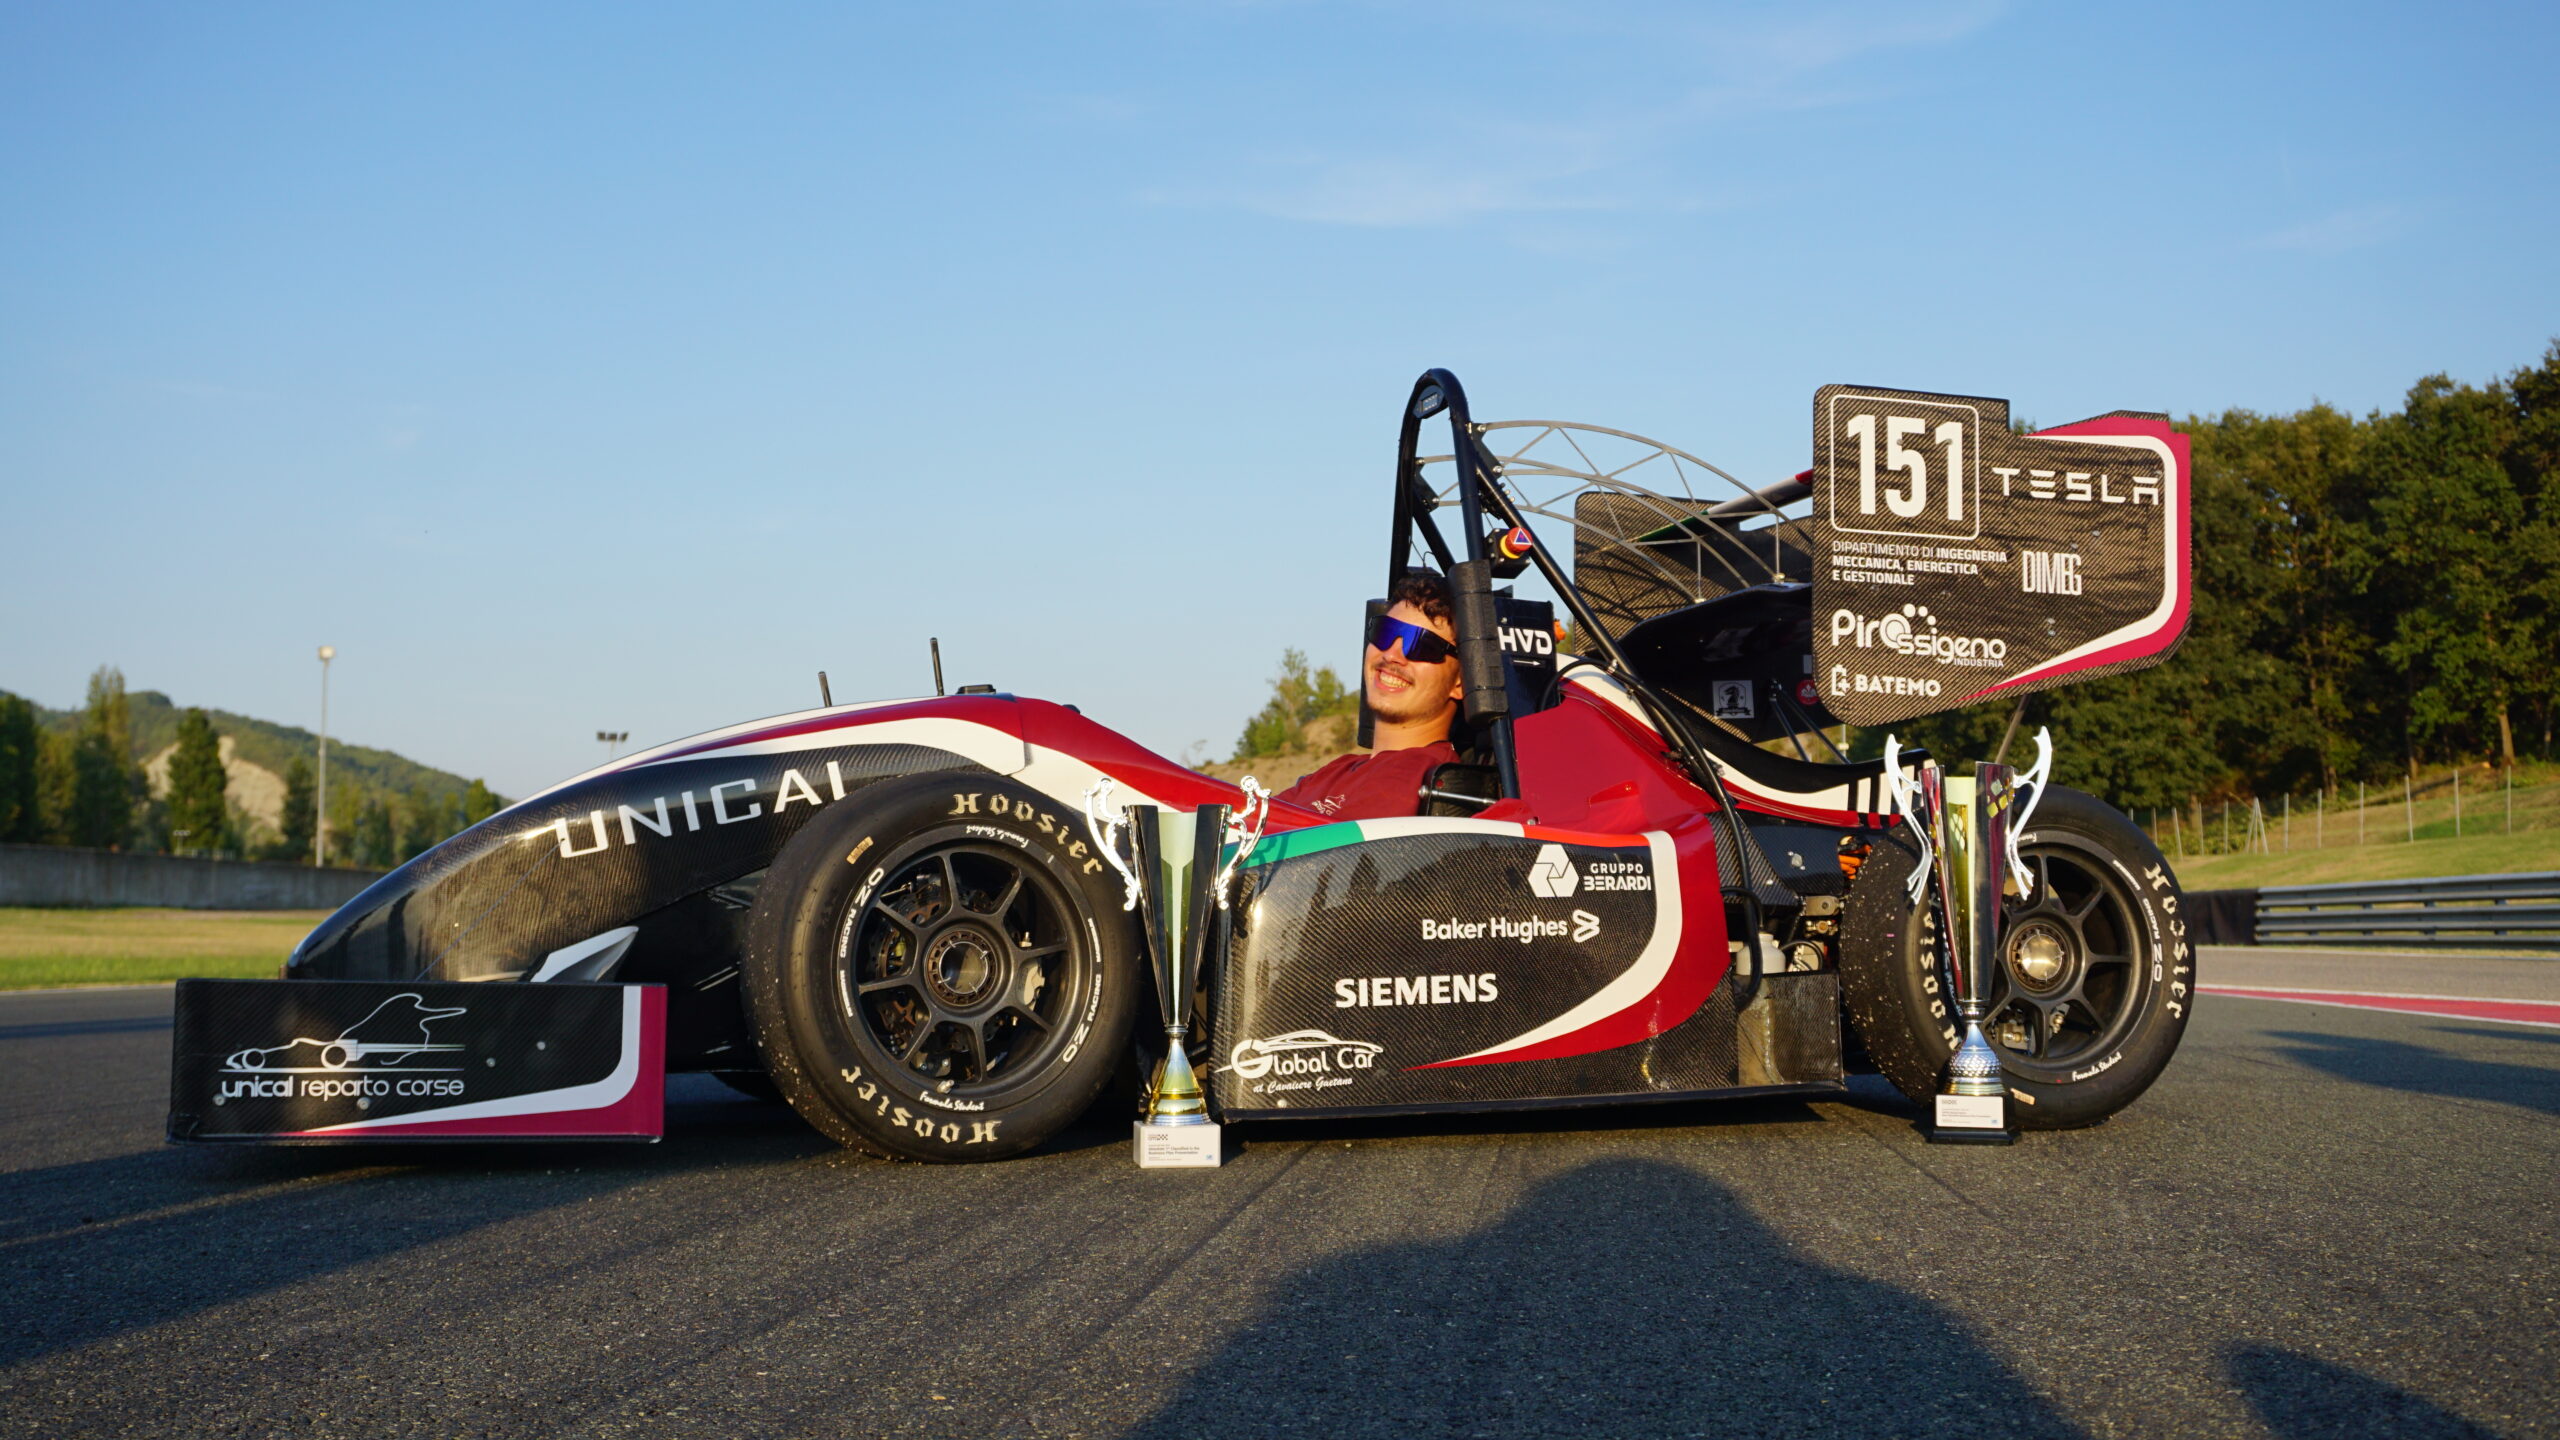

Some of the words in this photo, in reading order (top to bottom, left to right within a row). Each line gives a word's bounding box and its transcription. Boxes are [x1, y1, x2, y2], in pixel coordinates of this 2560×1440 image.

[1847, 413, 1963, 521] 151
[1991, 466, 2159, 506] TESLA
[1832, 540, 1919, 557] DIPARTIMENTO
[1922, 547, 1934, 558] DI
[1936, 547, 2008, 563] INGEGNERIA
[1832, 555, 1904, 572] MECCANICA,
[1906, 560, 1979, 575] ENERGETICA
[1832, 570, 1841, 581] E
[1843, 571, 1915, 586] GESTIONALE
[2022, 550, 2083, 596] DIMEG
[1497, 626, 1553, 655] HVD
[1953, 657, 2004, 668] INDUSTRIA
[1855, 674, 1942, 697] BATEMO
[948, 793, 1103, 875] Hoosier
[1583, 876, 1652, 891] BERARDI
[1590, 863, 1644, 874] GRUPPO
[839, 908, 857, 958] RACING
[1422, 917, 1487, 941] Baker
[1490, 915, 1568, 943] Hughes
[2143, 862, 2190, 1020] Hoosier
[1087, 974, 1102, 1022] RACING
[1335, 973, 1499, 1008] SIEMENS
[1230, 1039, 1331, 1079] Global
[1337, 1047, 1376, 1069] Car
[221, 1075, 294, 1098] unical
[301, 1075, 390, 1102] reparto
[395, 1079, 465, 1097] corse
[841, 1066, 1003, 1144] Hoosier
